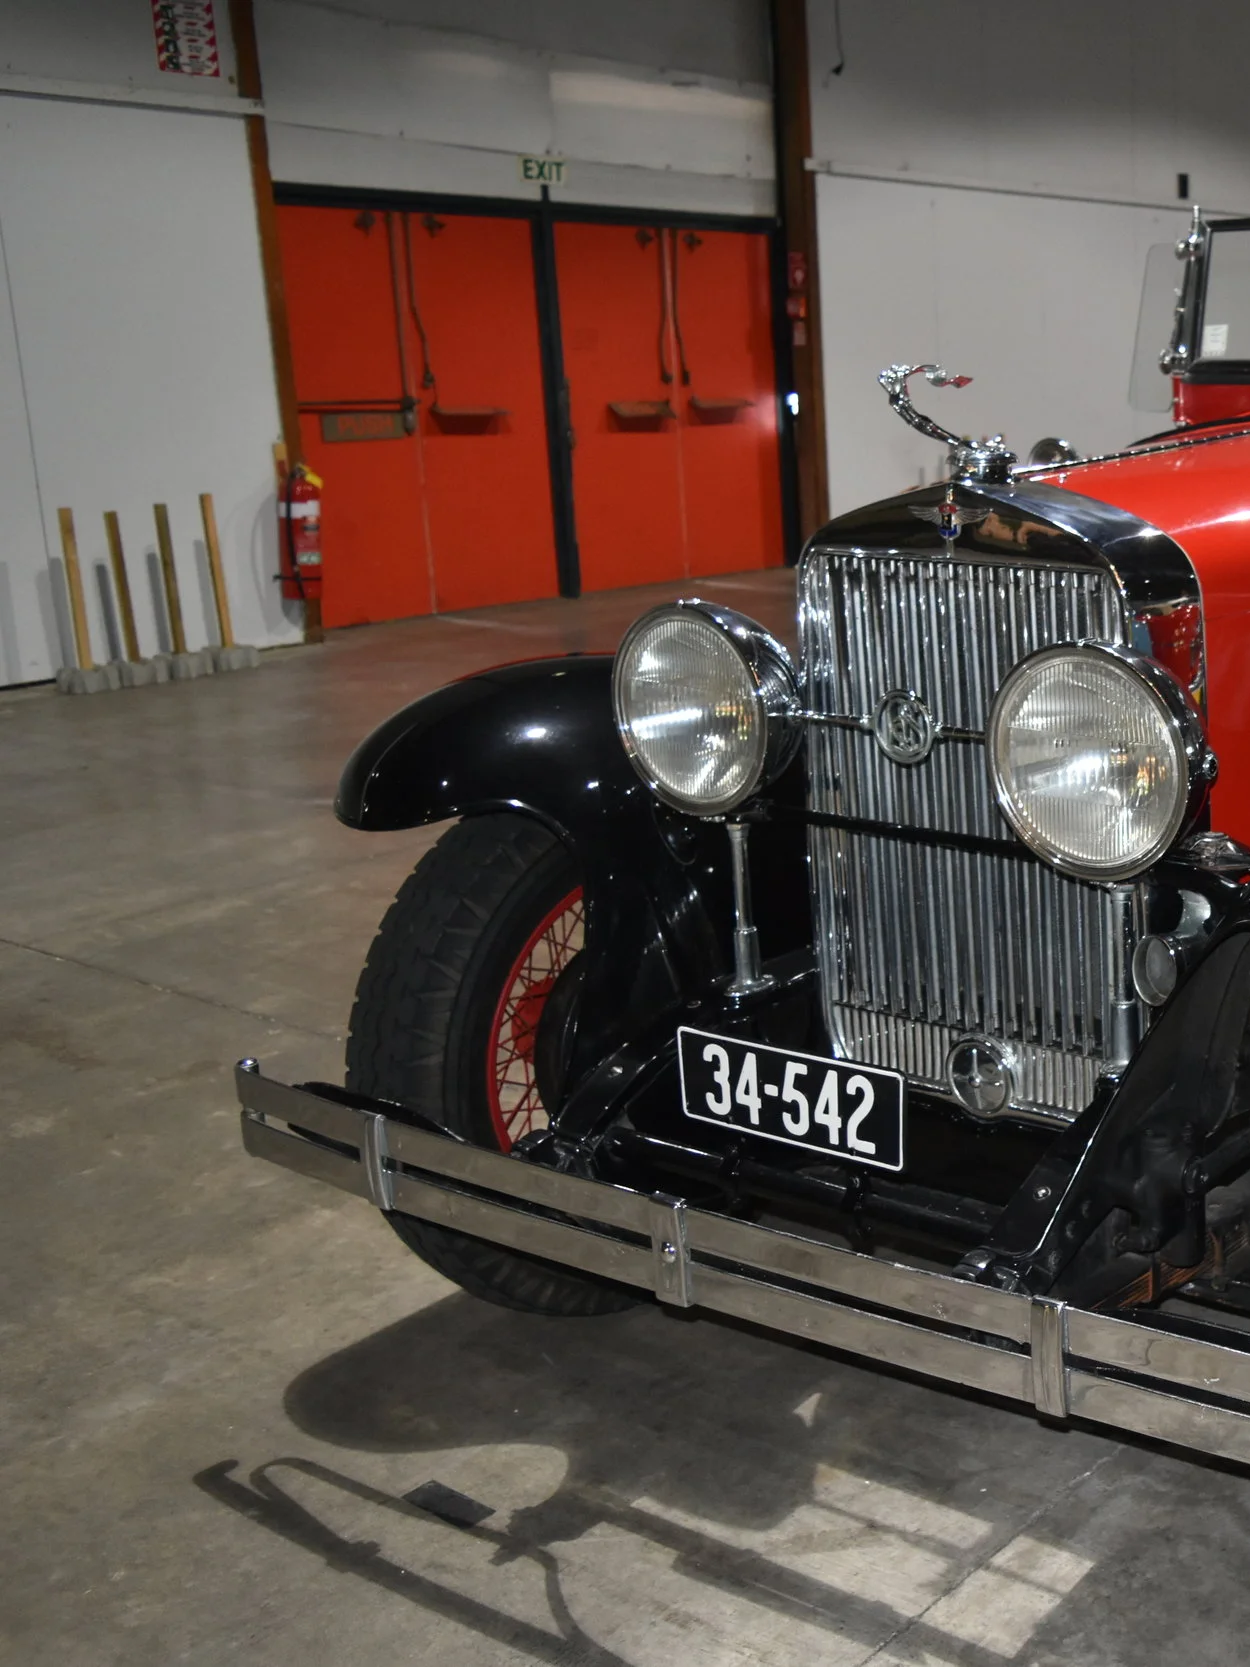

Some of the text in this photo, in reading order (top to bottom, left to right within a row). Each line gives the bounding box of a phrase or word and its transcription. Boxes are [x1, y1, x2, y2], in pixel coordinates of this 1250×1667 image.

[523, 158, 564, 181] EXIT
[337, 414, 394, 436] PUSH
[703, 1043, 876, 1155] 34-542
